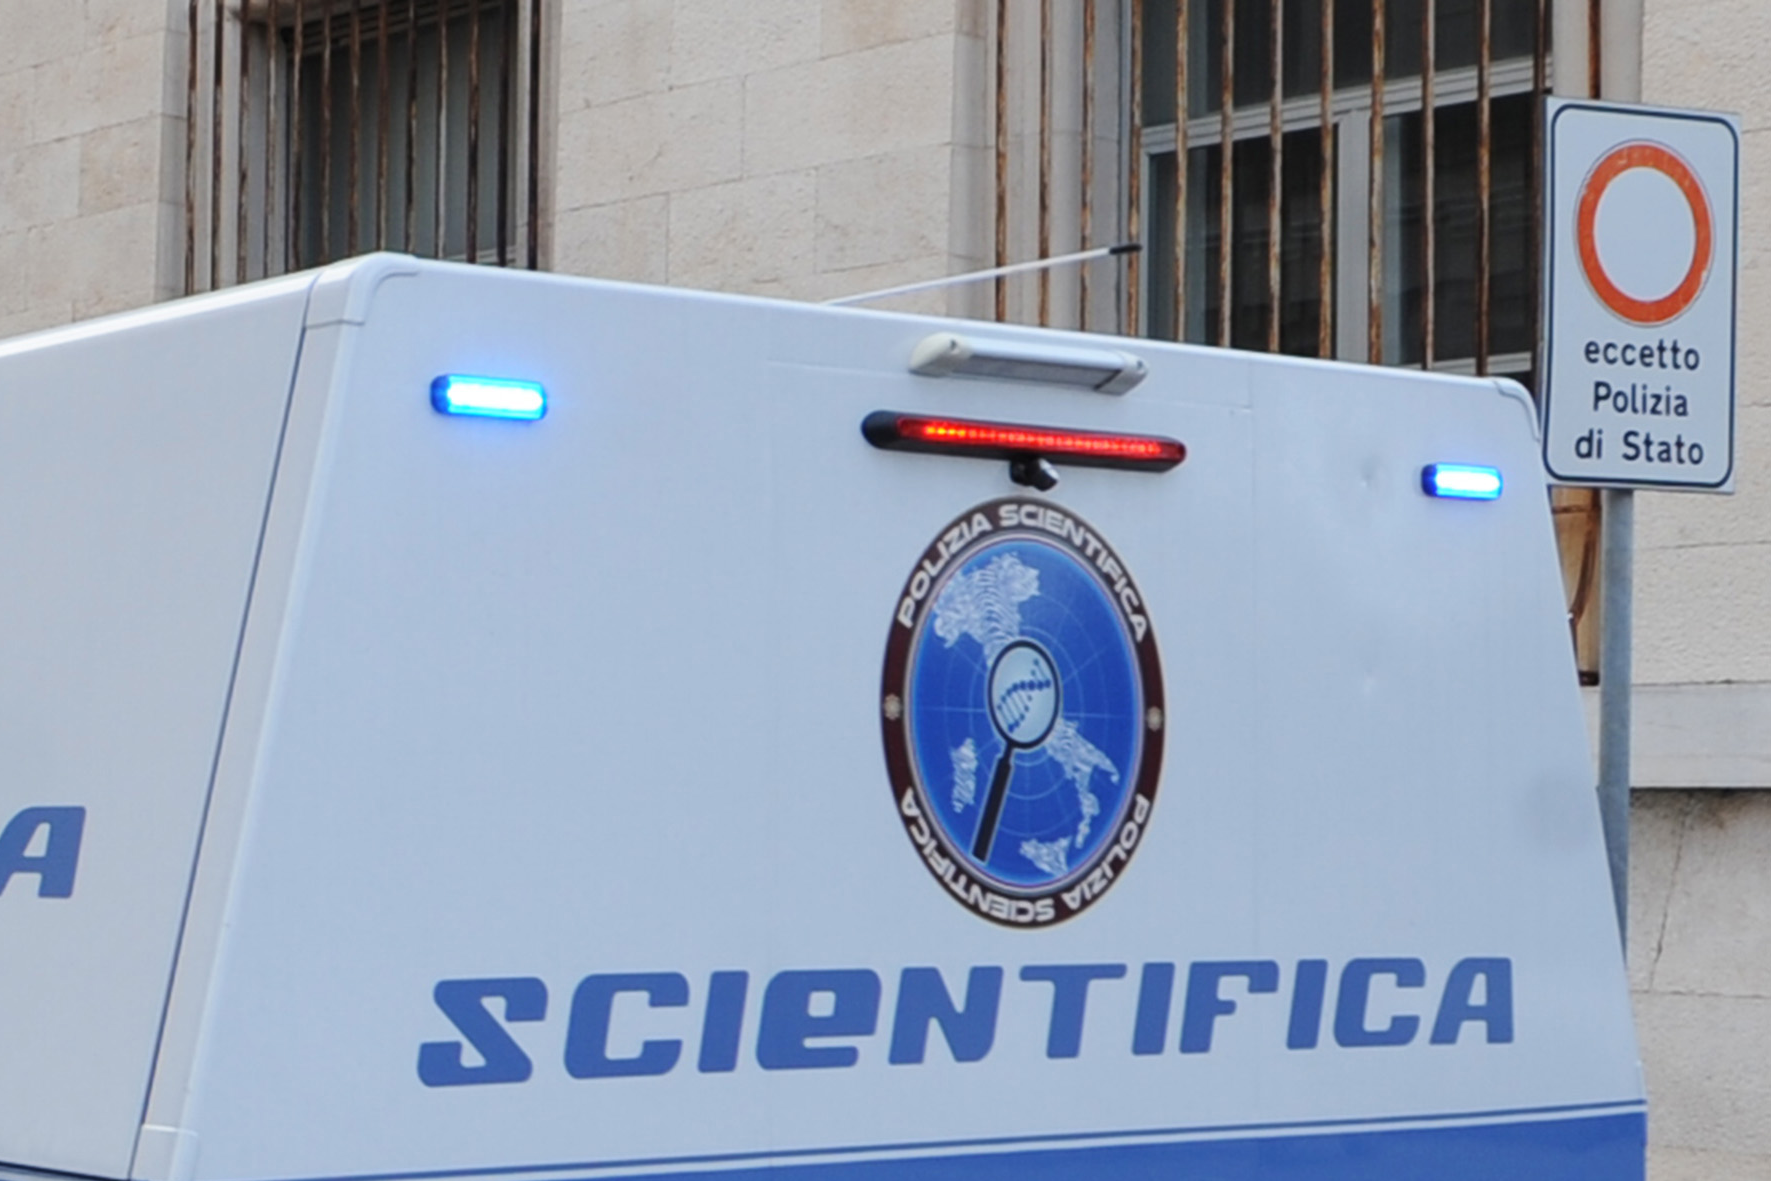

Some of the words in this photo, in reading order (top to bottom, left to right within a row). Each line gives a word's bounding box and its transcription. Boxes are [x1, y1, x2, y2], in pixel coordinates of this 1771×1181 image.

[1585, 340, 1700, 370] eccetto
[1594, 381, 1688, 416] Polizia
[1575, 428, 1603, 460] di
[1622, 431, 1704, 464] Stato
[897, 512, 993, 628] POLIZIA
[998, 504, 1148, 642] SCIENTIFICA
[901, 787, 1056, 923] SCIENTIFICA
[1061, 793, 1150, 912] POLIZIA
